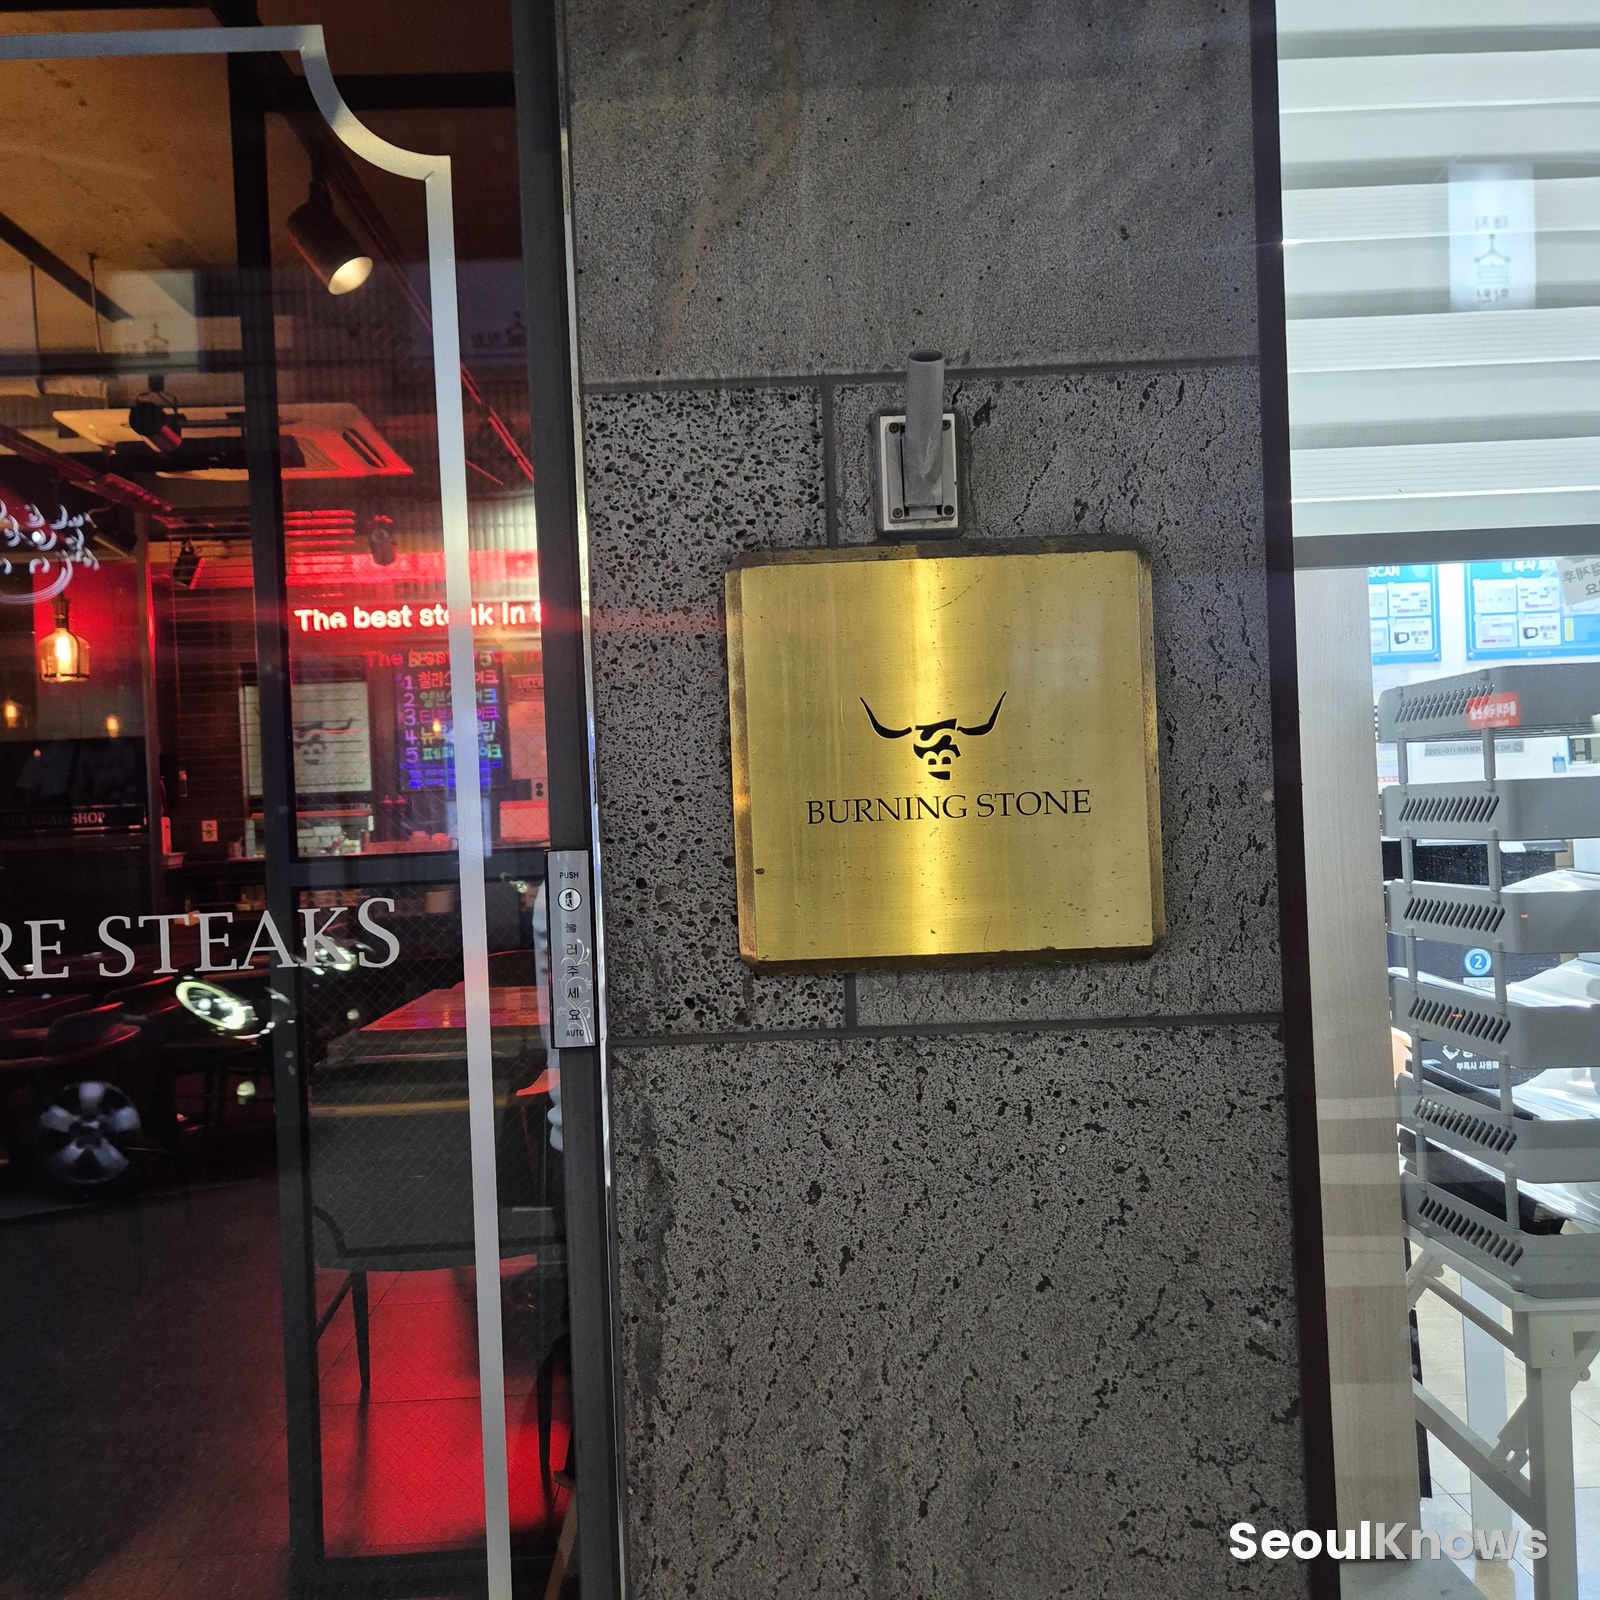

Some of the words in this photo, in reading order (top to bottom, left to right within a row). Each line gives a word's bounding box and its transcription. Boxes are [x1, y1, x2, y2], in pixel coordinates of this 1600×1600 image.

[293, 608, 347, 632] The
[353, 605, 413, 629] best
[806, 794, 968, 824] BURNING
[977, 789, 1092, 818] STONE
[71, 811, 106, 825] SHOP
[559, 872, 579, 880] PUSH
[99, 898, 401, 978] STEAKS
[1474, 955, 1483, 969] 2
[566, 1029, 585, 1037] AUTO
